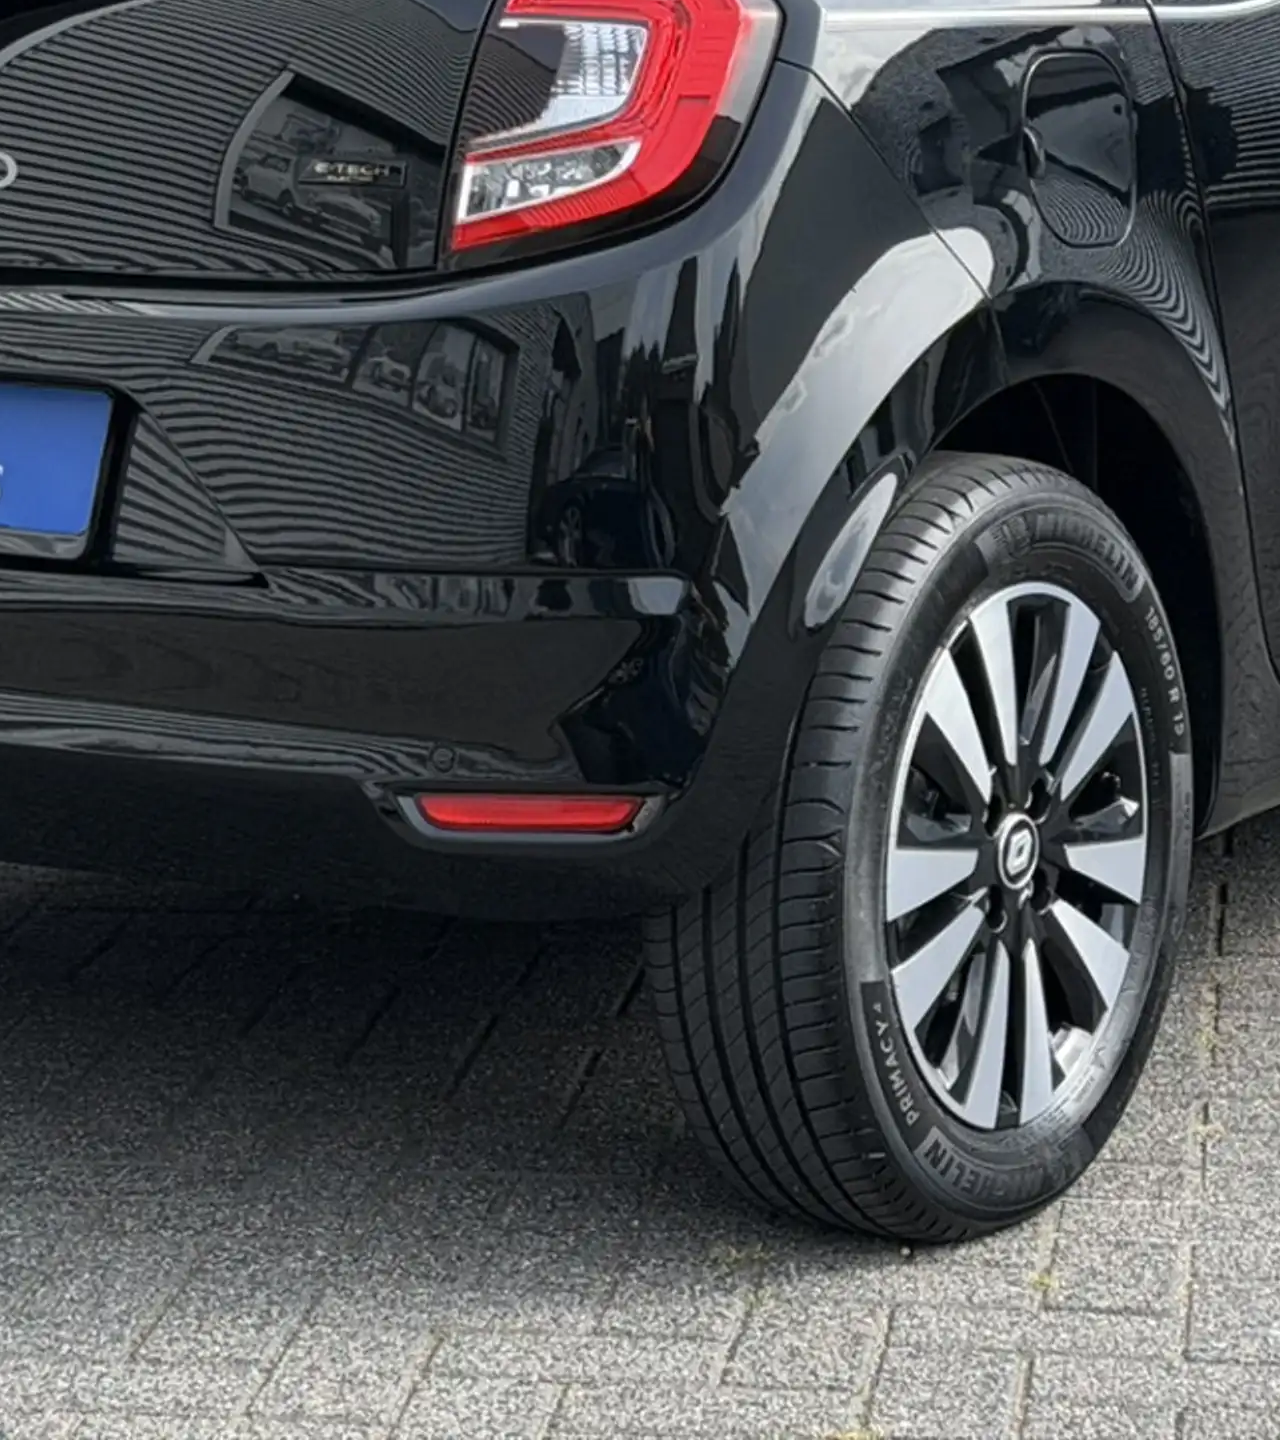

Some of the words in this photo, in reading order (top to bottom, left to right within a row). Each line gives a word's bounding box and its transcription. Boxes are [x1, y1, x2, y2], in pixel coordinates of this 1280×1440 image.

[1035, 513, 1140, 592] MICHELIN
[1143, 606, 1176, 681] 185/60
[875, 1019, 920, 1127] PRIMACY
